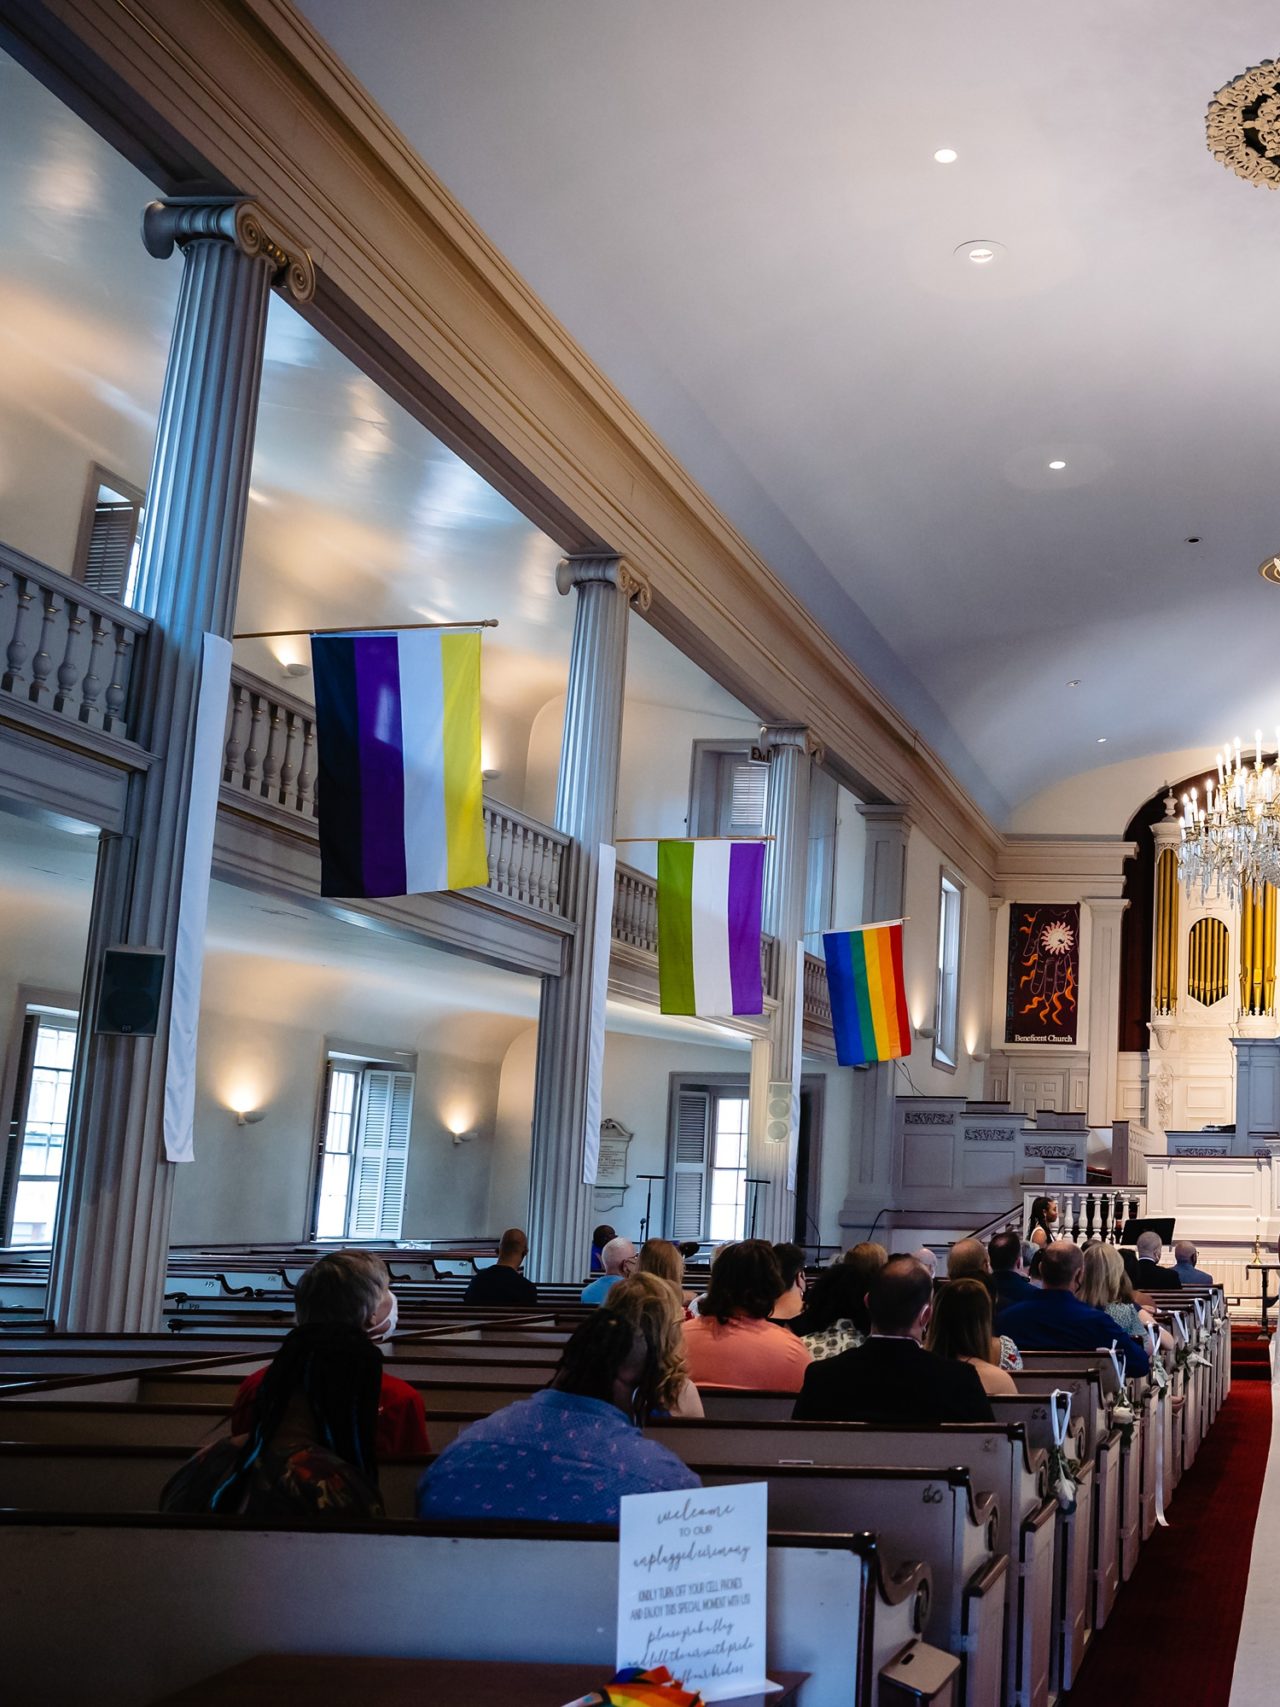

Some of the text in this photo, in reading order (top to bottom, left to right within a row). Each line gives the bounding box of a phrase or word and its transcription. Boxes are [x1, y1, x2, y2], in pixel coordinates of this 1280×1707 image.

[657, 1498, 735, 1525] welcome
[680, 1524, 712, 1537] TO OUR
[633, 1541, 750, 1574] unplugged ceremony
[676, 1583, 687, 1597] OFF
[689, 1581, 704, 1596] YOUR
[706, 1579, 719, 1593] CELL
[630, 1607, 644, 1621] AND
